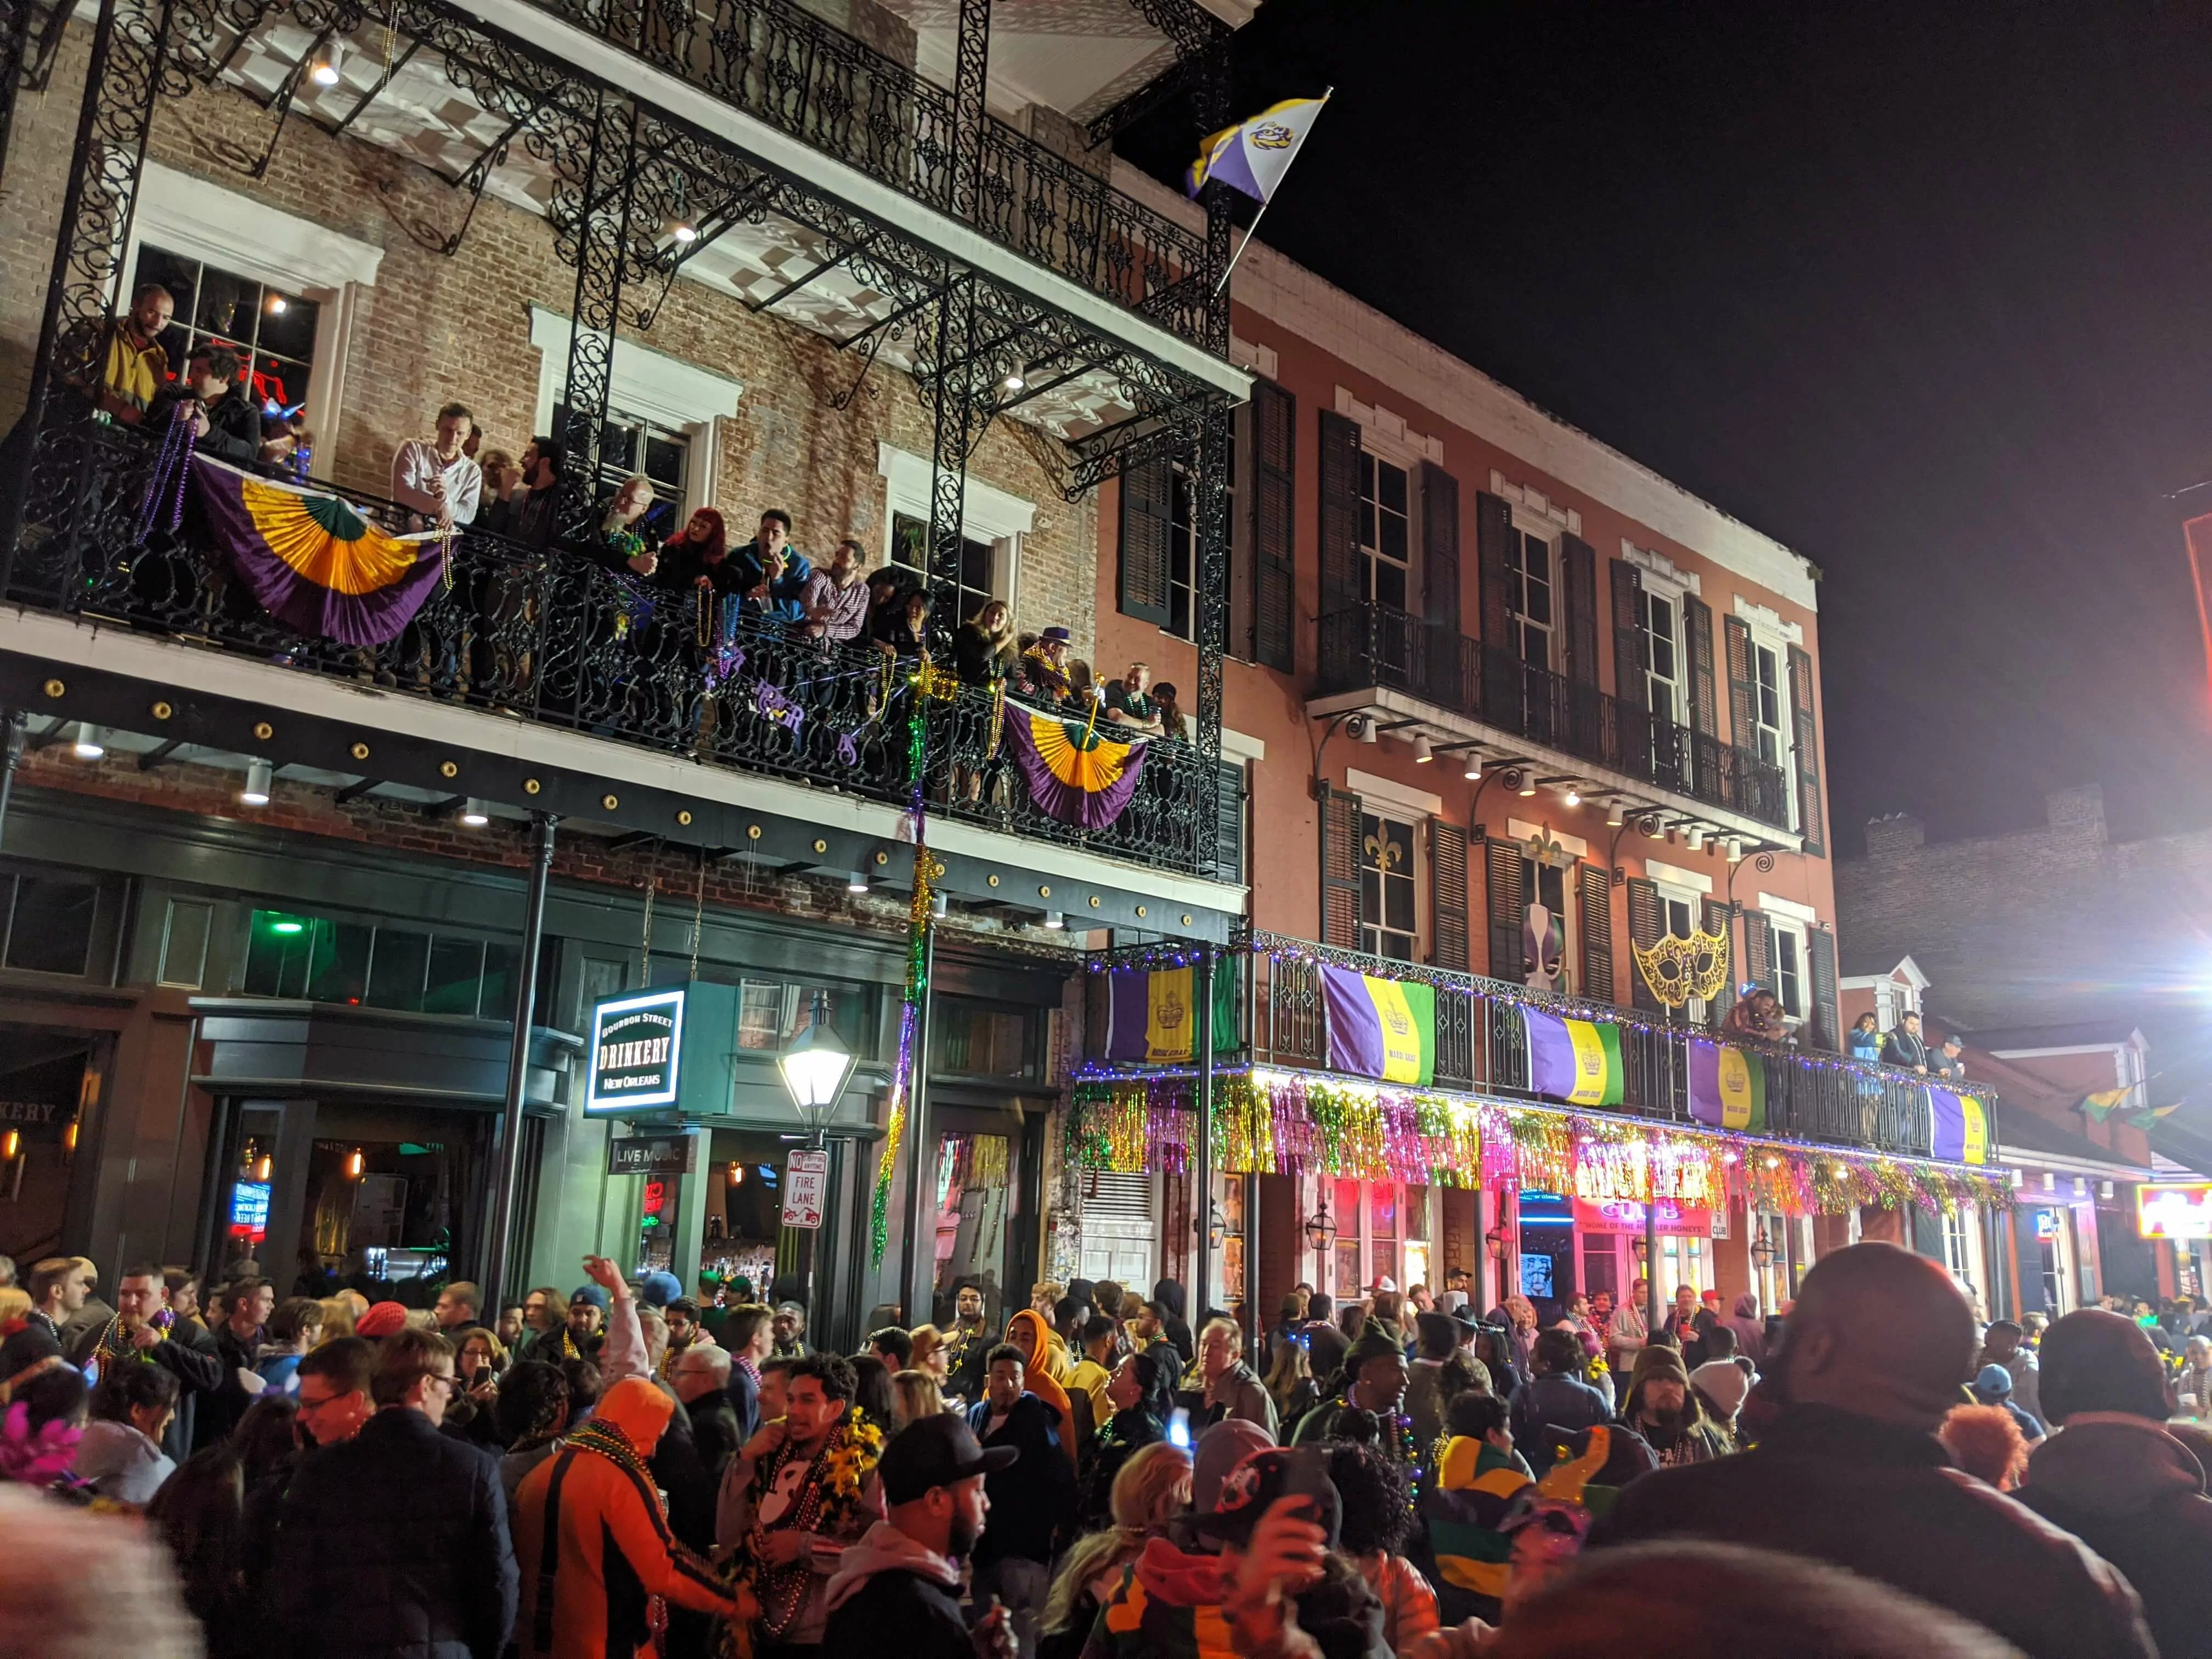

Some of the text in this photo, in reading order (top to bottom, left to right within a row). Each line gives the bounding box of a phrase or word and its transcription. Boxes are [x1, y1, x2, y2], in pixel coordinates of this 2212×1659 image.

[602, 1013, 673, 1039] BOURBON STREET
[599, 1037, 670, 1070] DRINKERY
[1389, 1049, 1415, 1062] MARDI GRAS
[603, 1074, 661, 1090] NEW ORLEANS
[617, 1148, 680, 1163] LIVE MUSIC
[790, 1155, 802, 1169] NO
[796, 1176, 815, 1189] FIRE
[792, 1192, 815, 1205] LANE
[1637, 1223, 1669, 1232] HULER
[1713, 1226, 1726, 1235] CLUB
